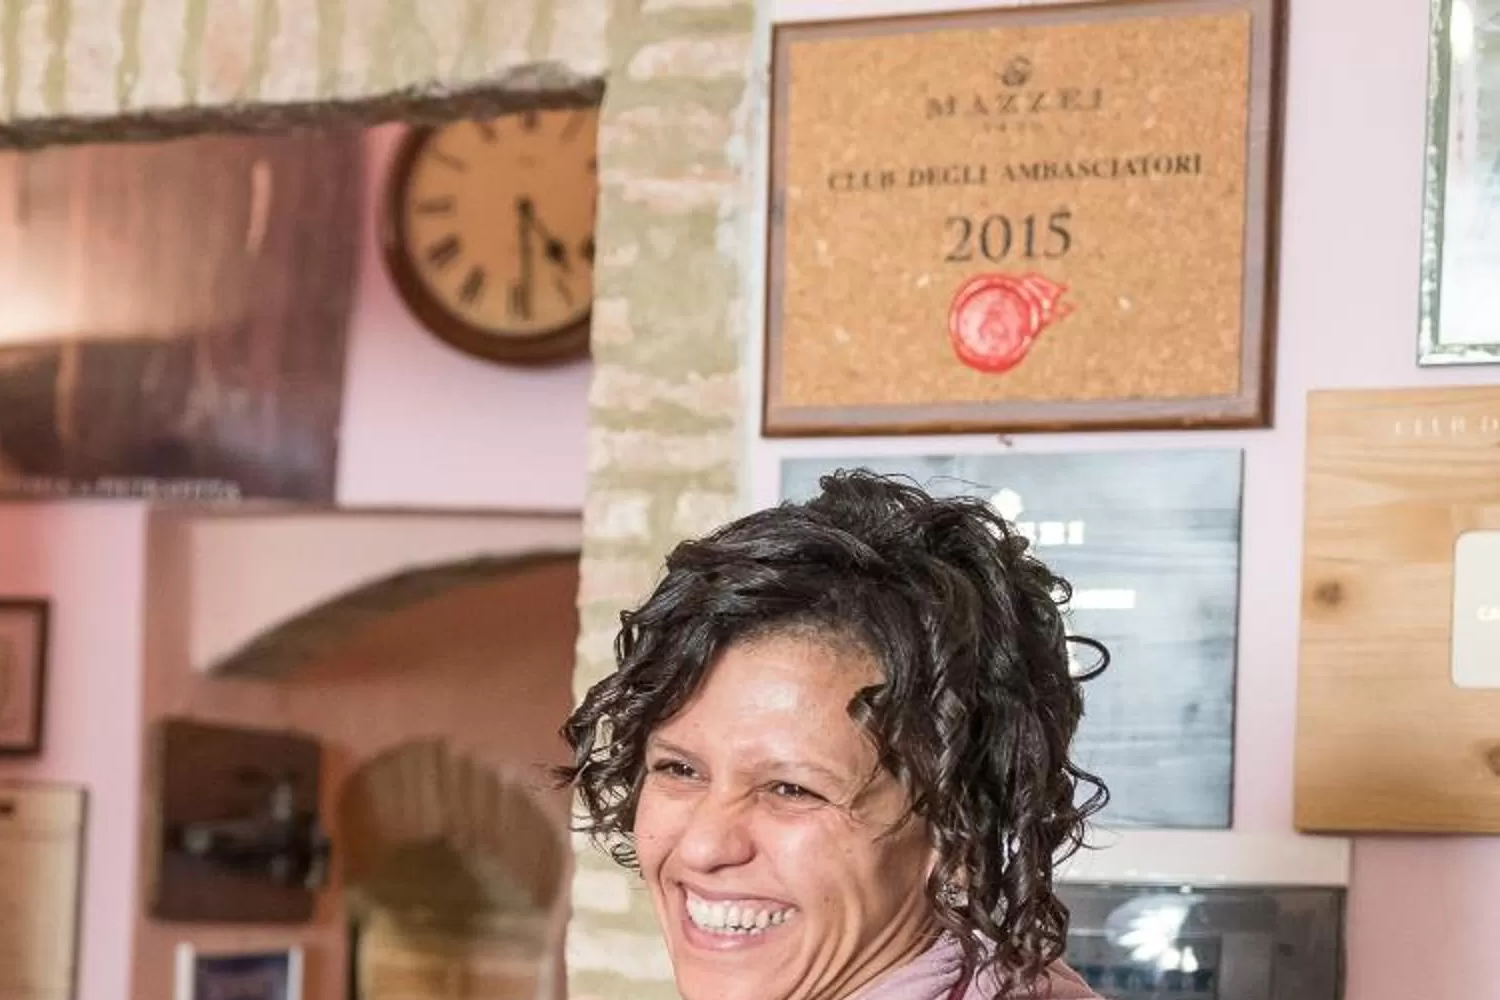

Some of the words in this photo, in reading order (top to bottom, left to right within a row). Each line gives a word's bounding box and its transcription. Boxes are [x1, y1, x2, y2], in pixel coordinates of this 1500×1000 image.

[924, 86, 1104, 121] MAZZEI
[826, 167, 896, 193] CLUB
[907, 160, 989, 190] DEGLI
[1002, 152, 1203, 183] AMBASCIATORI
[943, 209, 1073, 265] 2015
